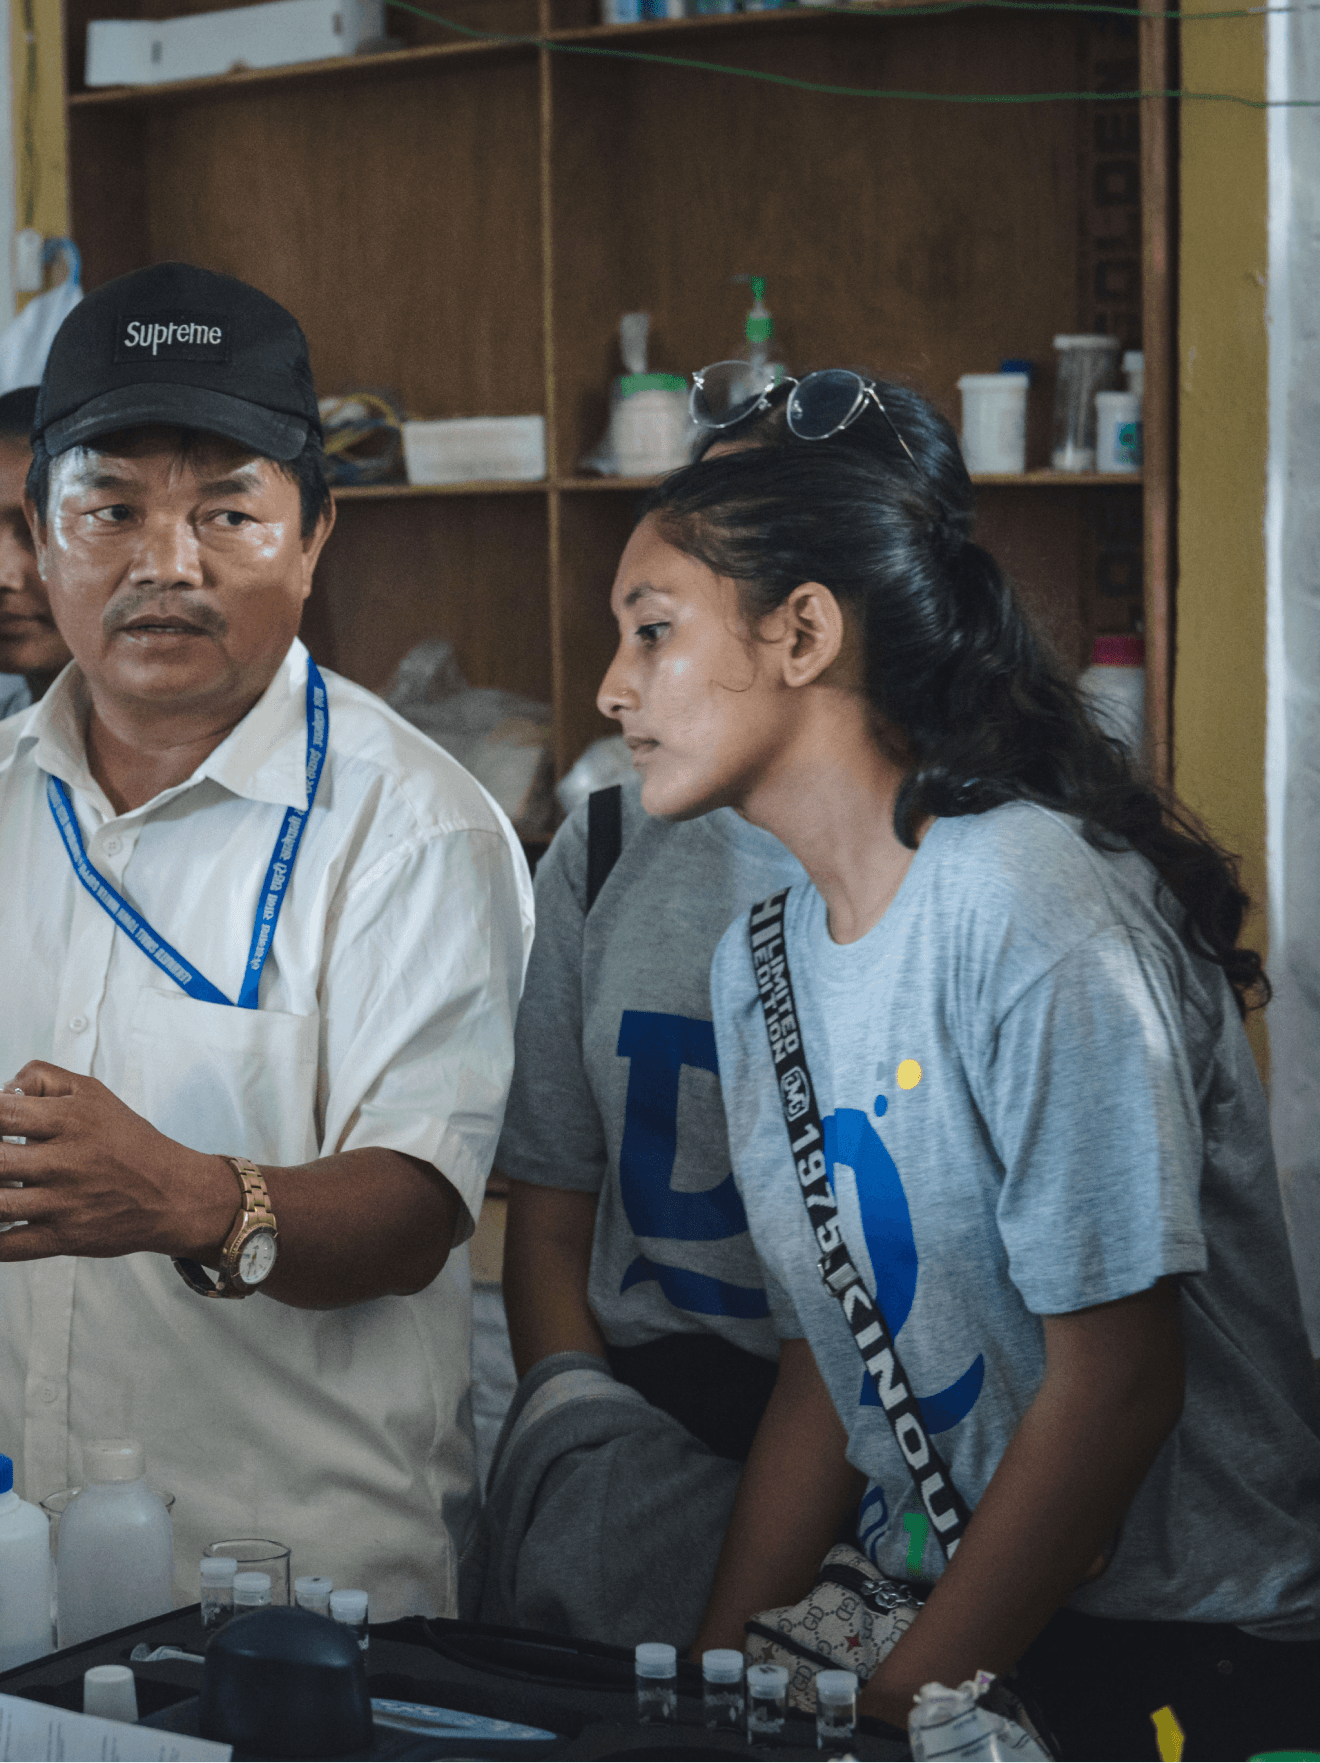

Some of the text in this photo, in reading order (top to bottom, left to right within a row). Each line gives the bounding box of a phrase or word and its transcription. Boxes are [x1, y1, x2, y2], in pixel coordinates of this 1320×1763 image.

[123, 321, 223, 356] Supreme
[753, 948, 788, 1064] EDITION
[766, 941, 801, 1055] LIMITED
[792, 1122, 842, 1254] 1975
